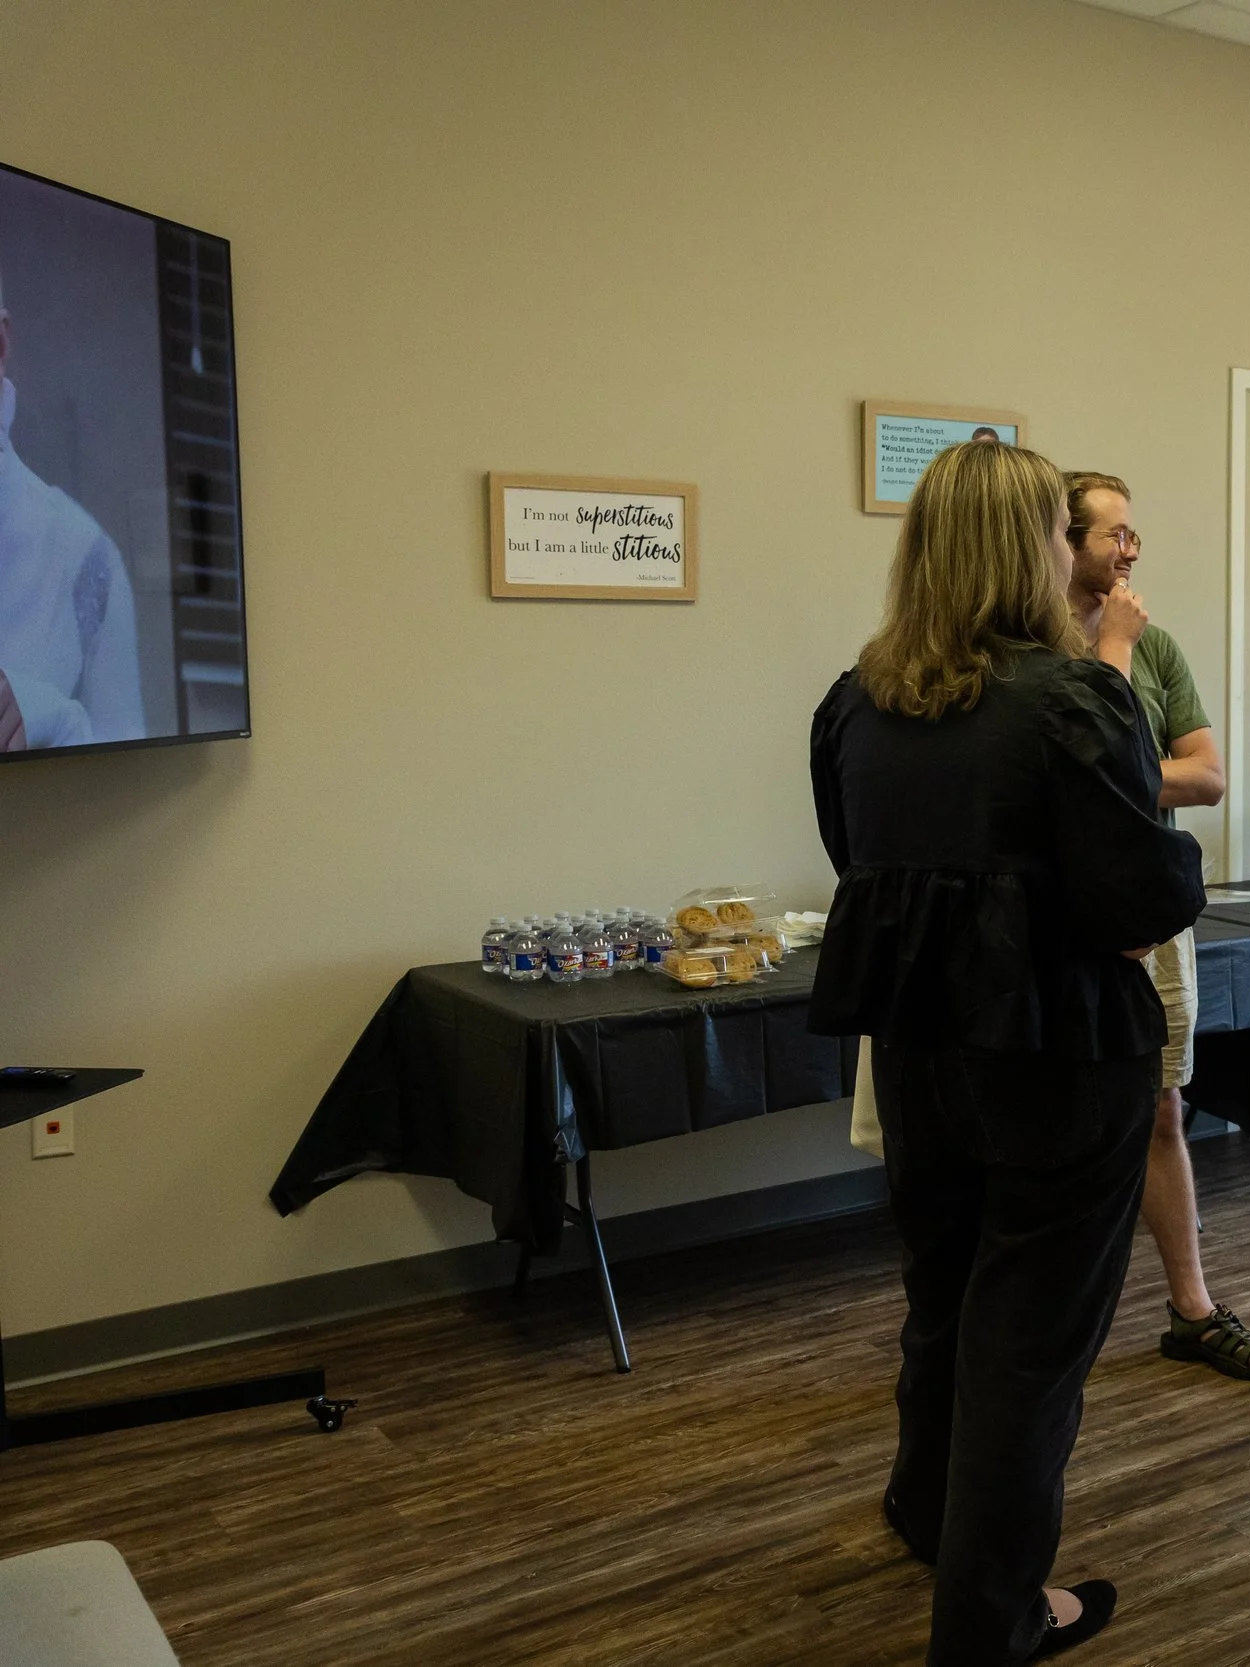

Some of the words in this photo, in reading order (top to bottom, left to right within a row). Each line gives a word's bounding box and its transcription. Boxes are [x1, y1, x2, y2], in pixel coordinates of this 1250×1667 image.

[881, 423, 913, 432] Whenever
[899, 436, 934, 446] something,
[904, 457, 918, 465] they
[523, 507, 545, 520] I'm
[549, 511, 569, 521] not
[576, 504, 673, 534] superstitious
[508, 538, 530, 551] but
[535, 539, 540, 552] I
[545, 543, 565, 552] am
[569, 544, 576, 553] a
[581, 541, 609, 554] little
[612, 534, 681, 563] stitious
